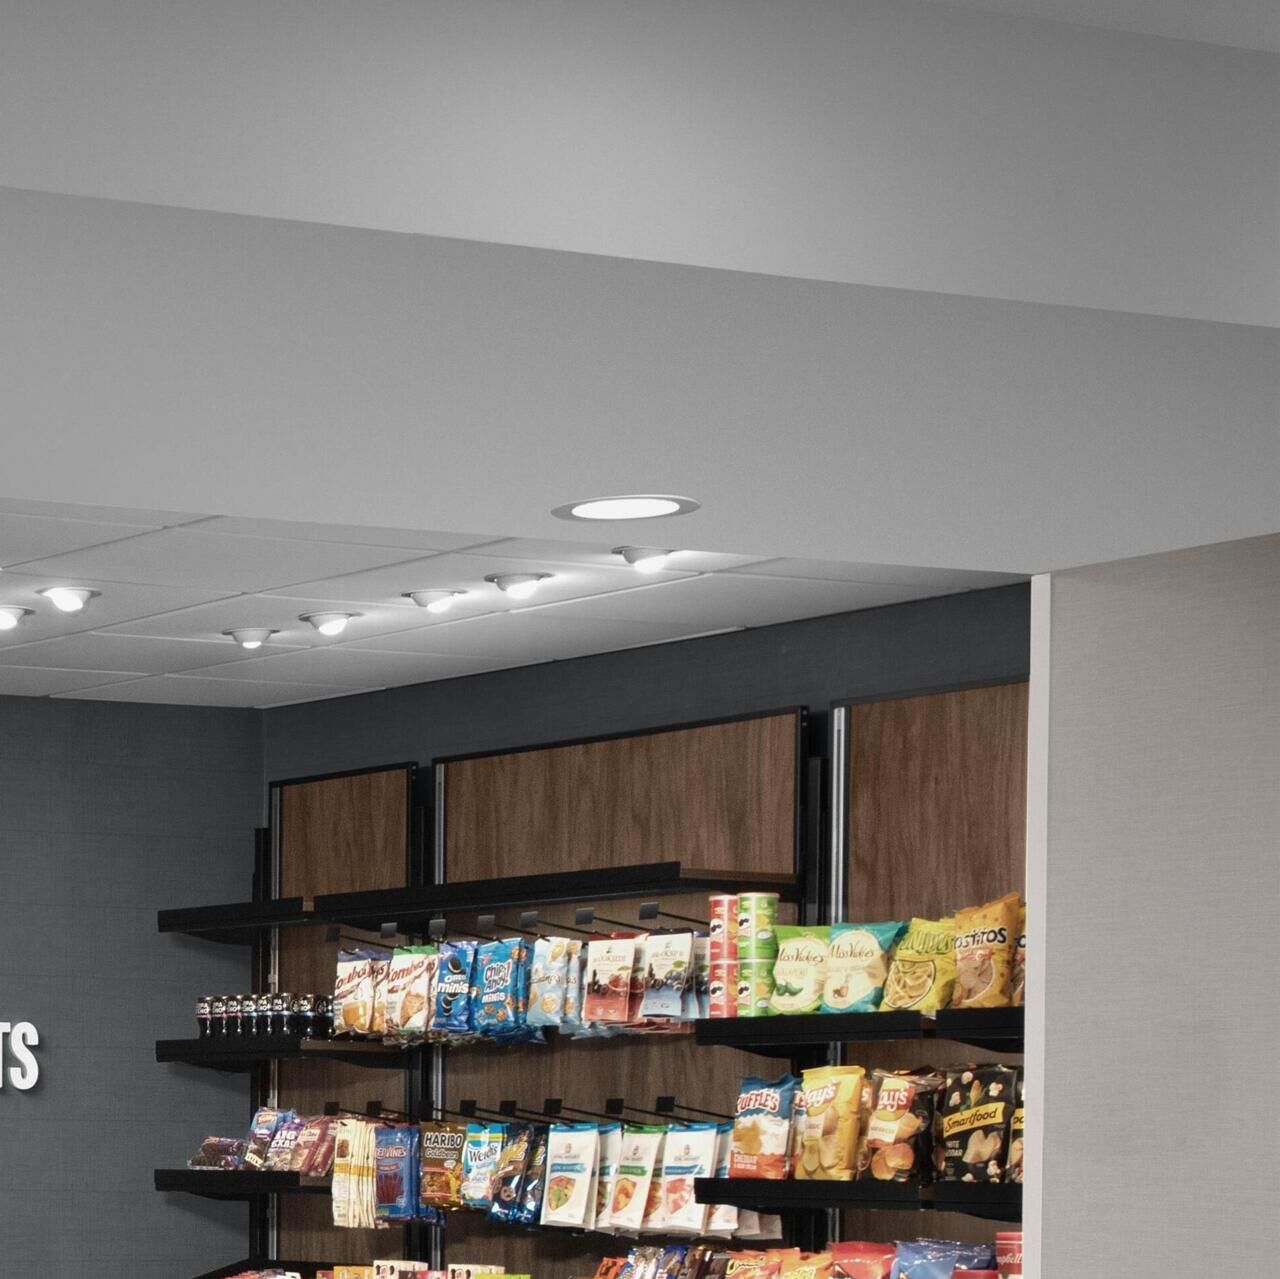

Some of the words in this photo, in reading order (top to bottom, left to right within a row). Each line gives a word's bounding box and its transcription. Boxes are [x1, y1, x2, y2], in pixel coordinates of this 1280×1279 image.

[953, 927, 1007, 950] OSTITOS
[389, 957, 426, 984] ombos
[438, 982, 470, 994] minis
[878, 1086, 908, 1111] ay's
[944, 1107, 999, 1134] Smartfood
[270, 1140, 297, 1150] EXAS
[423, 1131, 464, 1149] HARIBO
